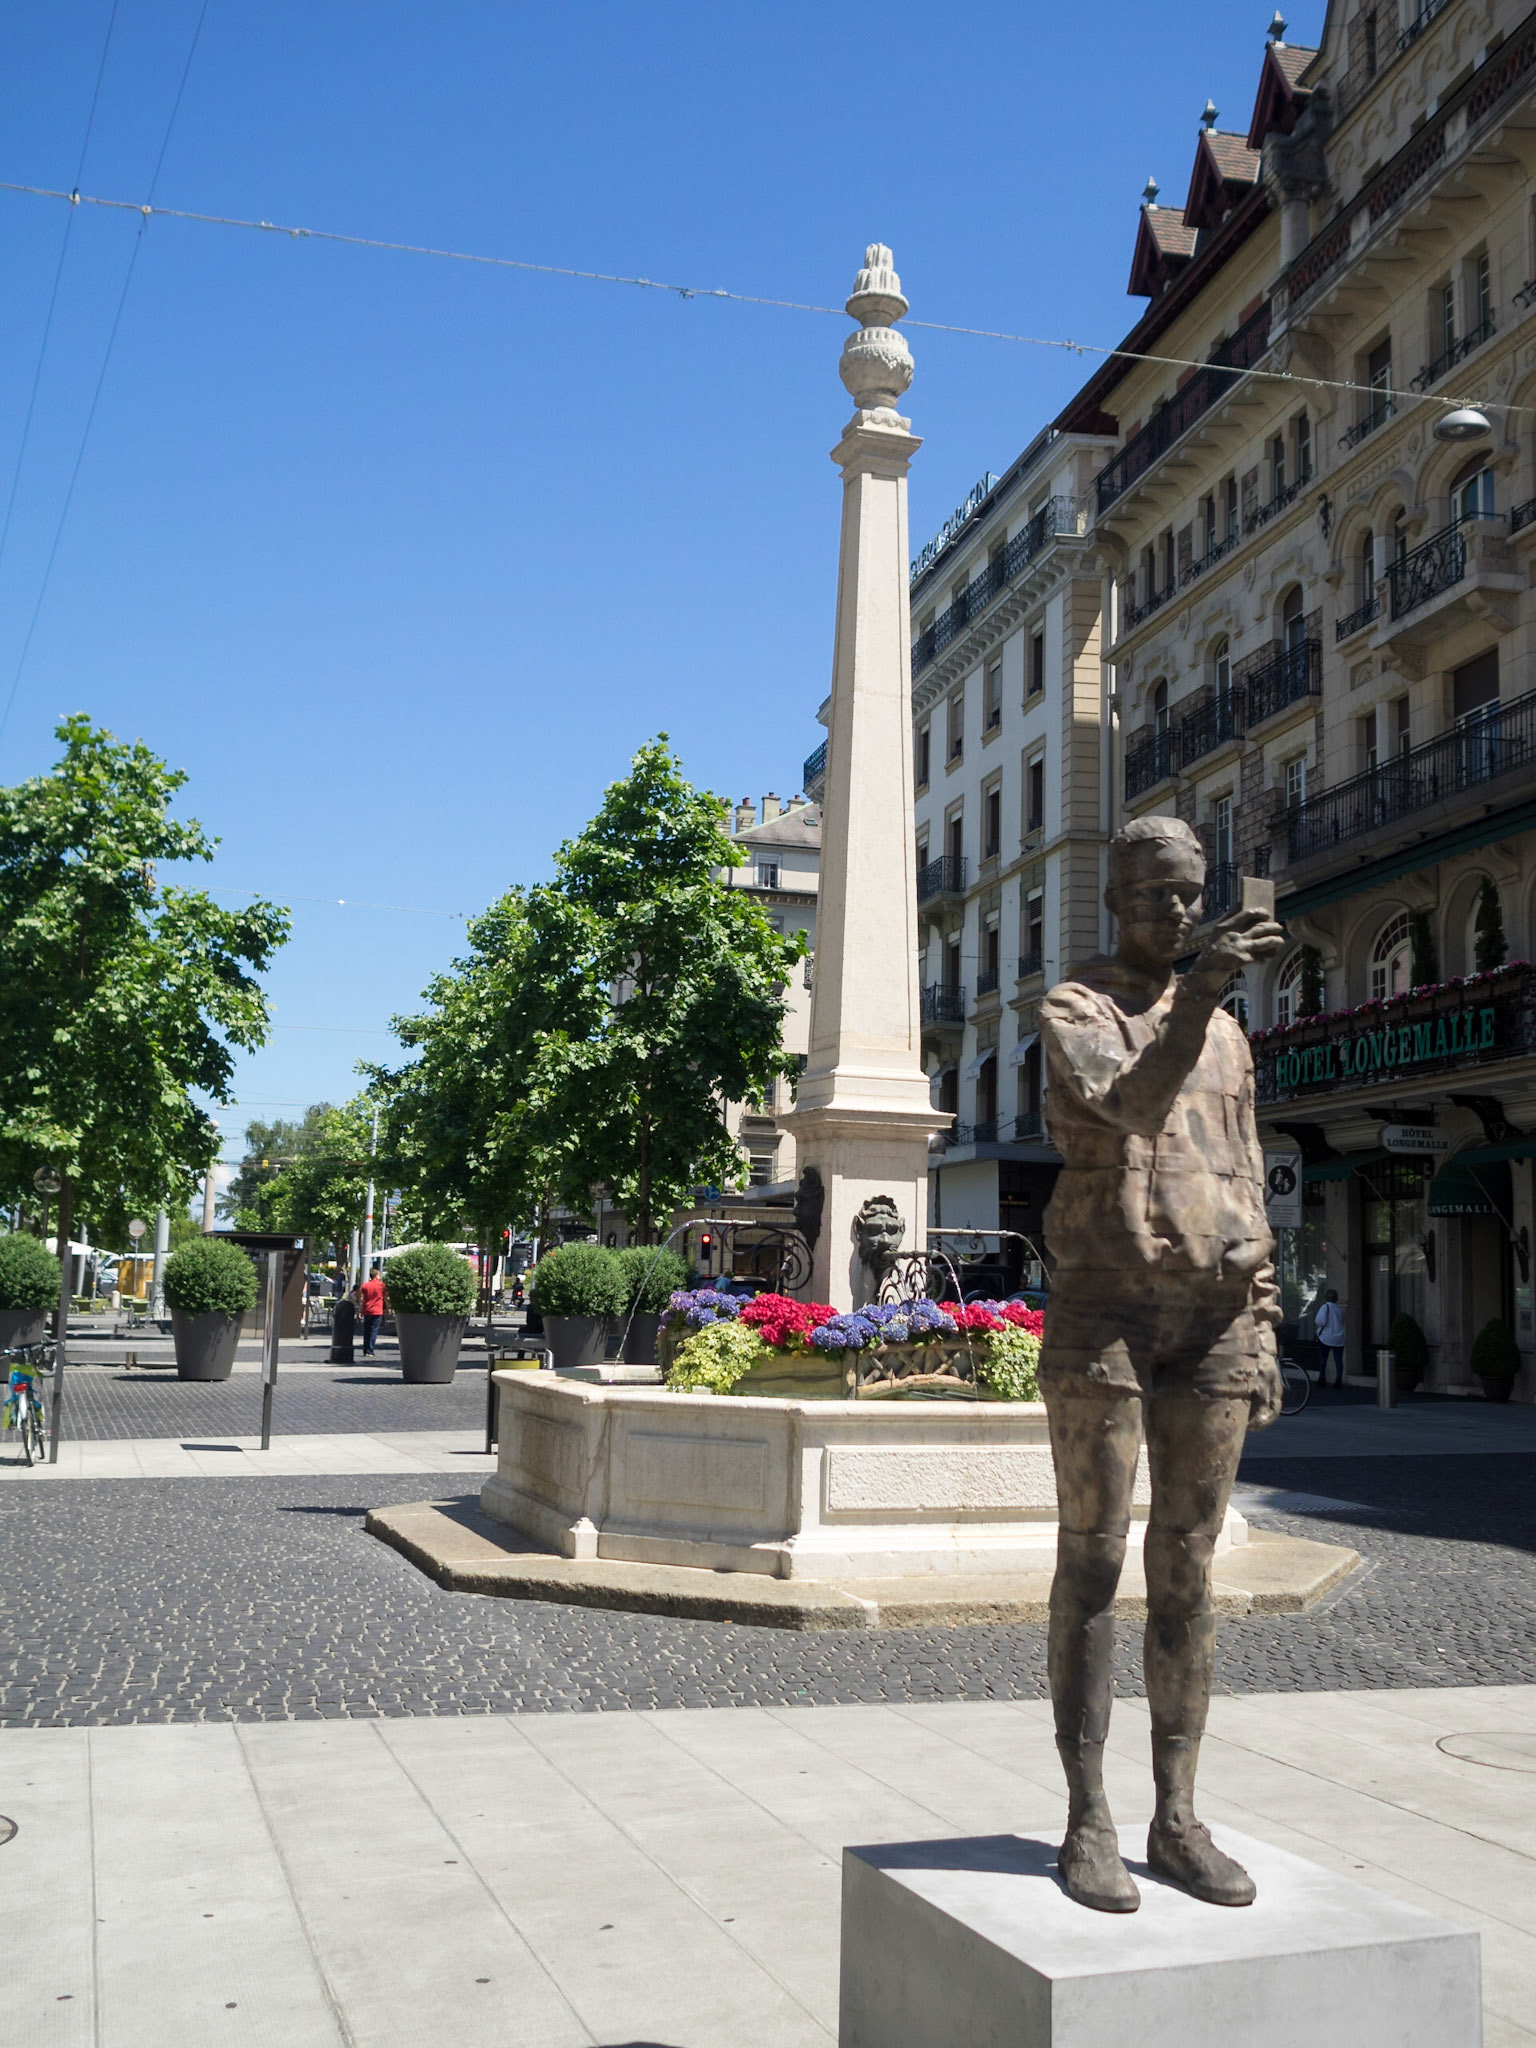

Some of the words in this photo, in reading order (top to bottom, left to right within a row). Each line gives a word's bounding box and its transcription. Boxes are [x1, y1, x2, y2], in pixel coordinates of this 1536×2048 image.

[1276, 1046, 1336, 1088] HÔTEL
[1343, 1008, 1495, 1076] LONGEMALLE
[1402, 1128, 1434, 1138] HÔTEL
[1387, 1139, 1449, 1149] LONGEMALLE
